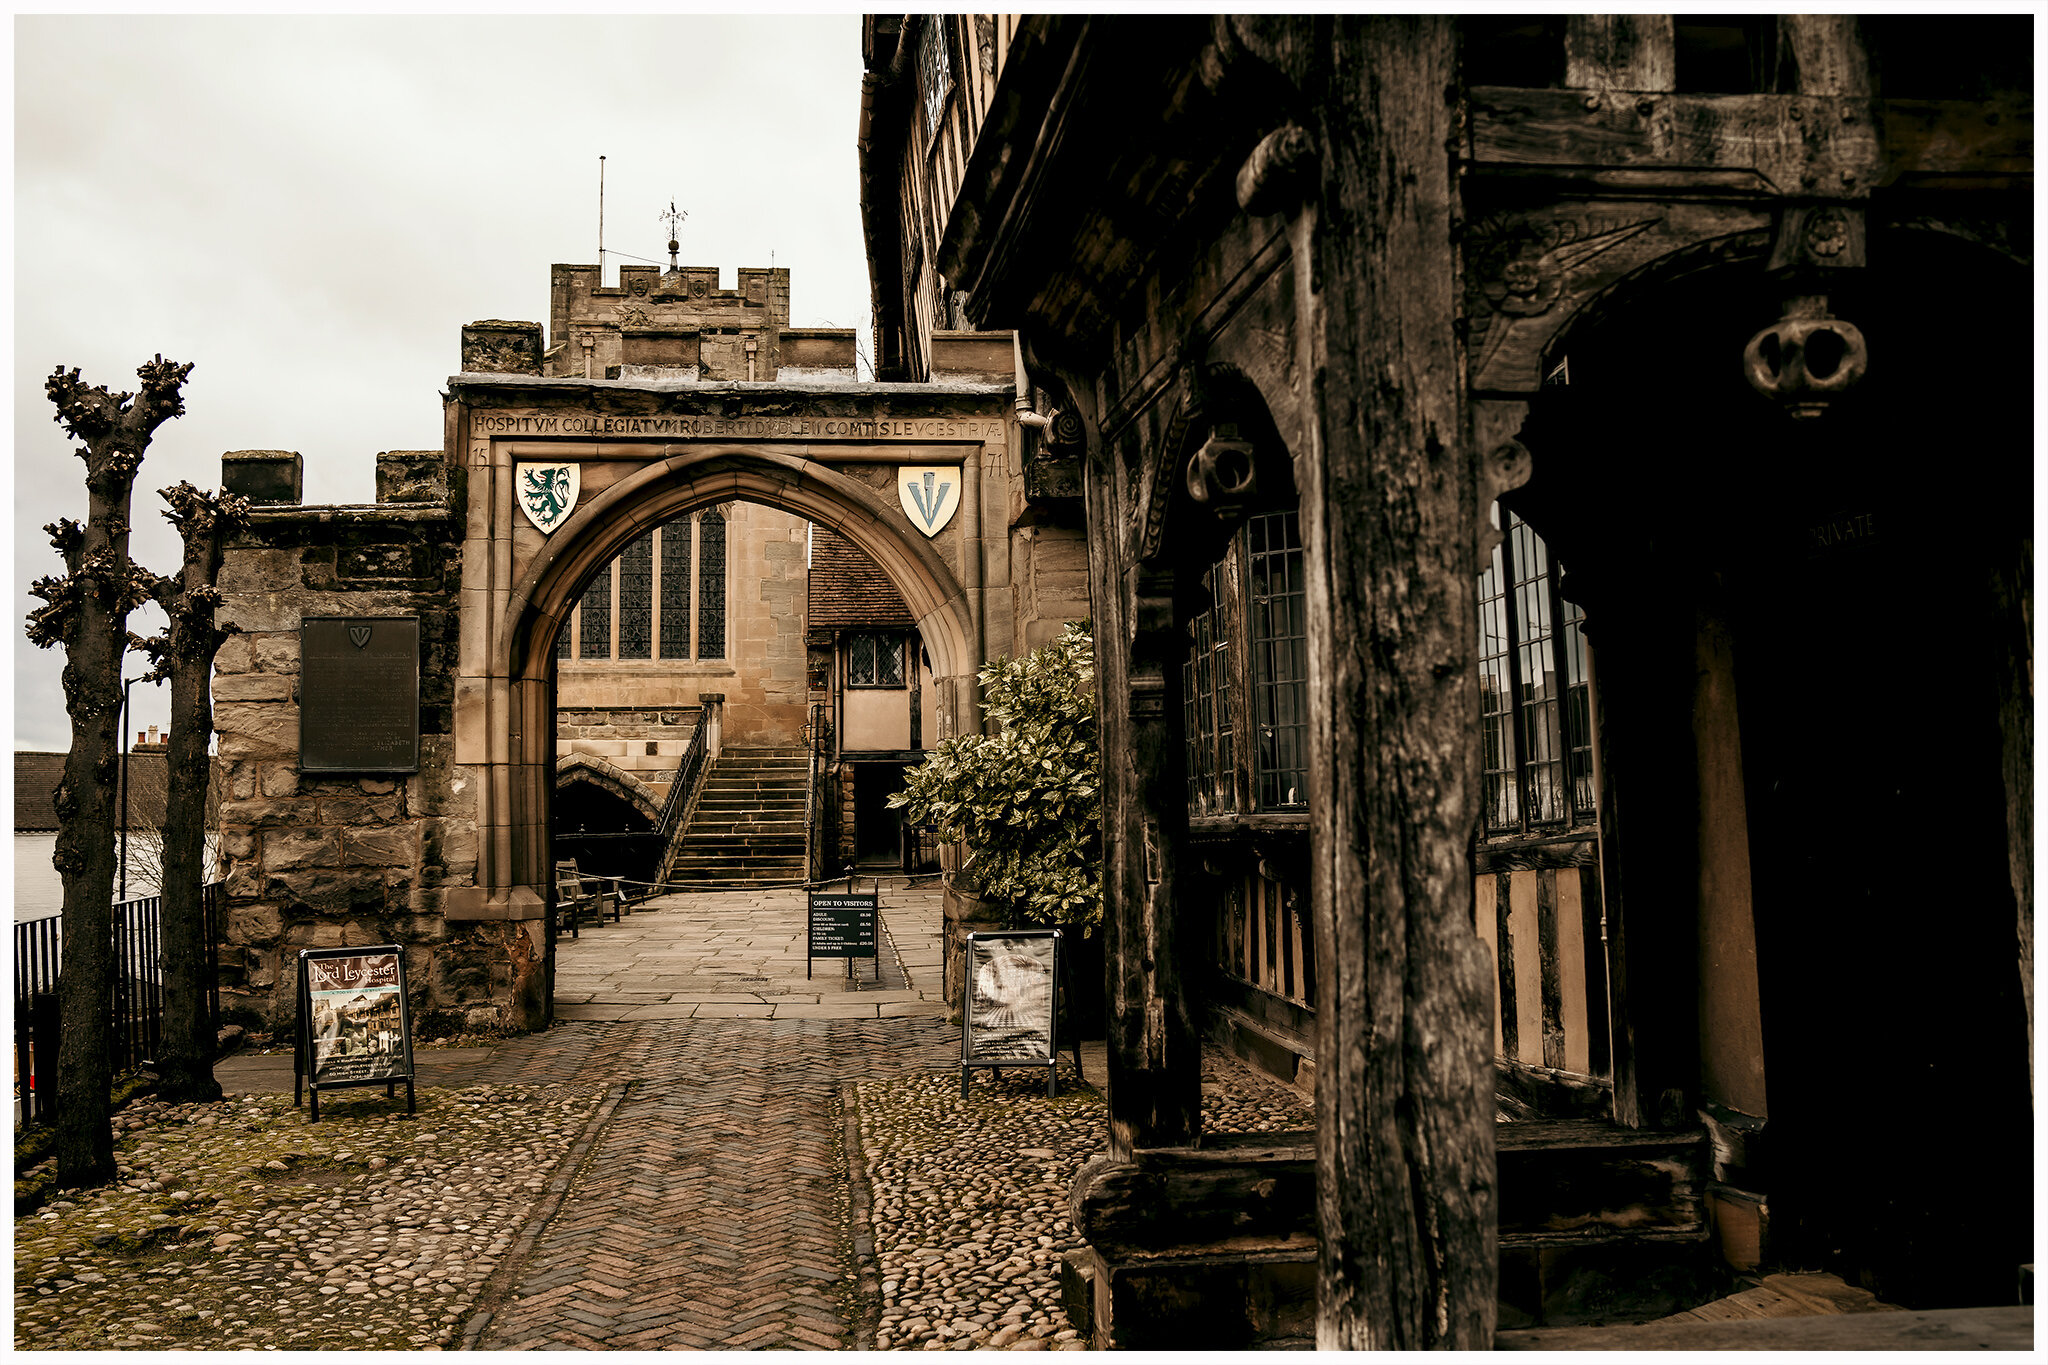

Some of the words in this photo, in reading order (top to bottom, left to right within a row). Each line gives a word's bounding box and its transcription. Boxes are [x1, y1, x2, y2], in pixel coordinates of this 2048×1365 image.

[987, 453, 1003, 478] 71
[314, 965, 340, 983] Lord
[343, 964, 396, 982] Leycester
[364, 976, 396, 984] Hospital
